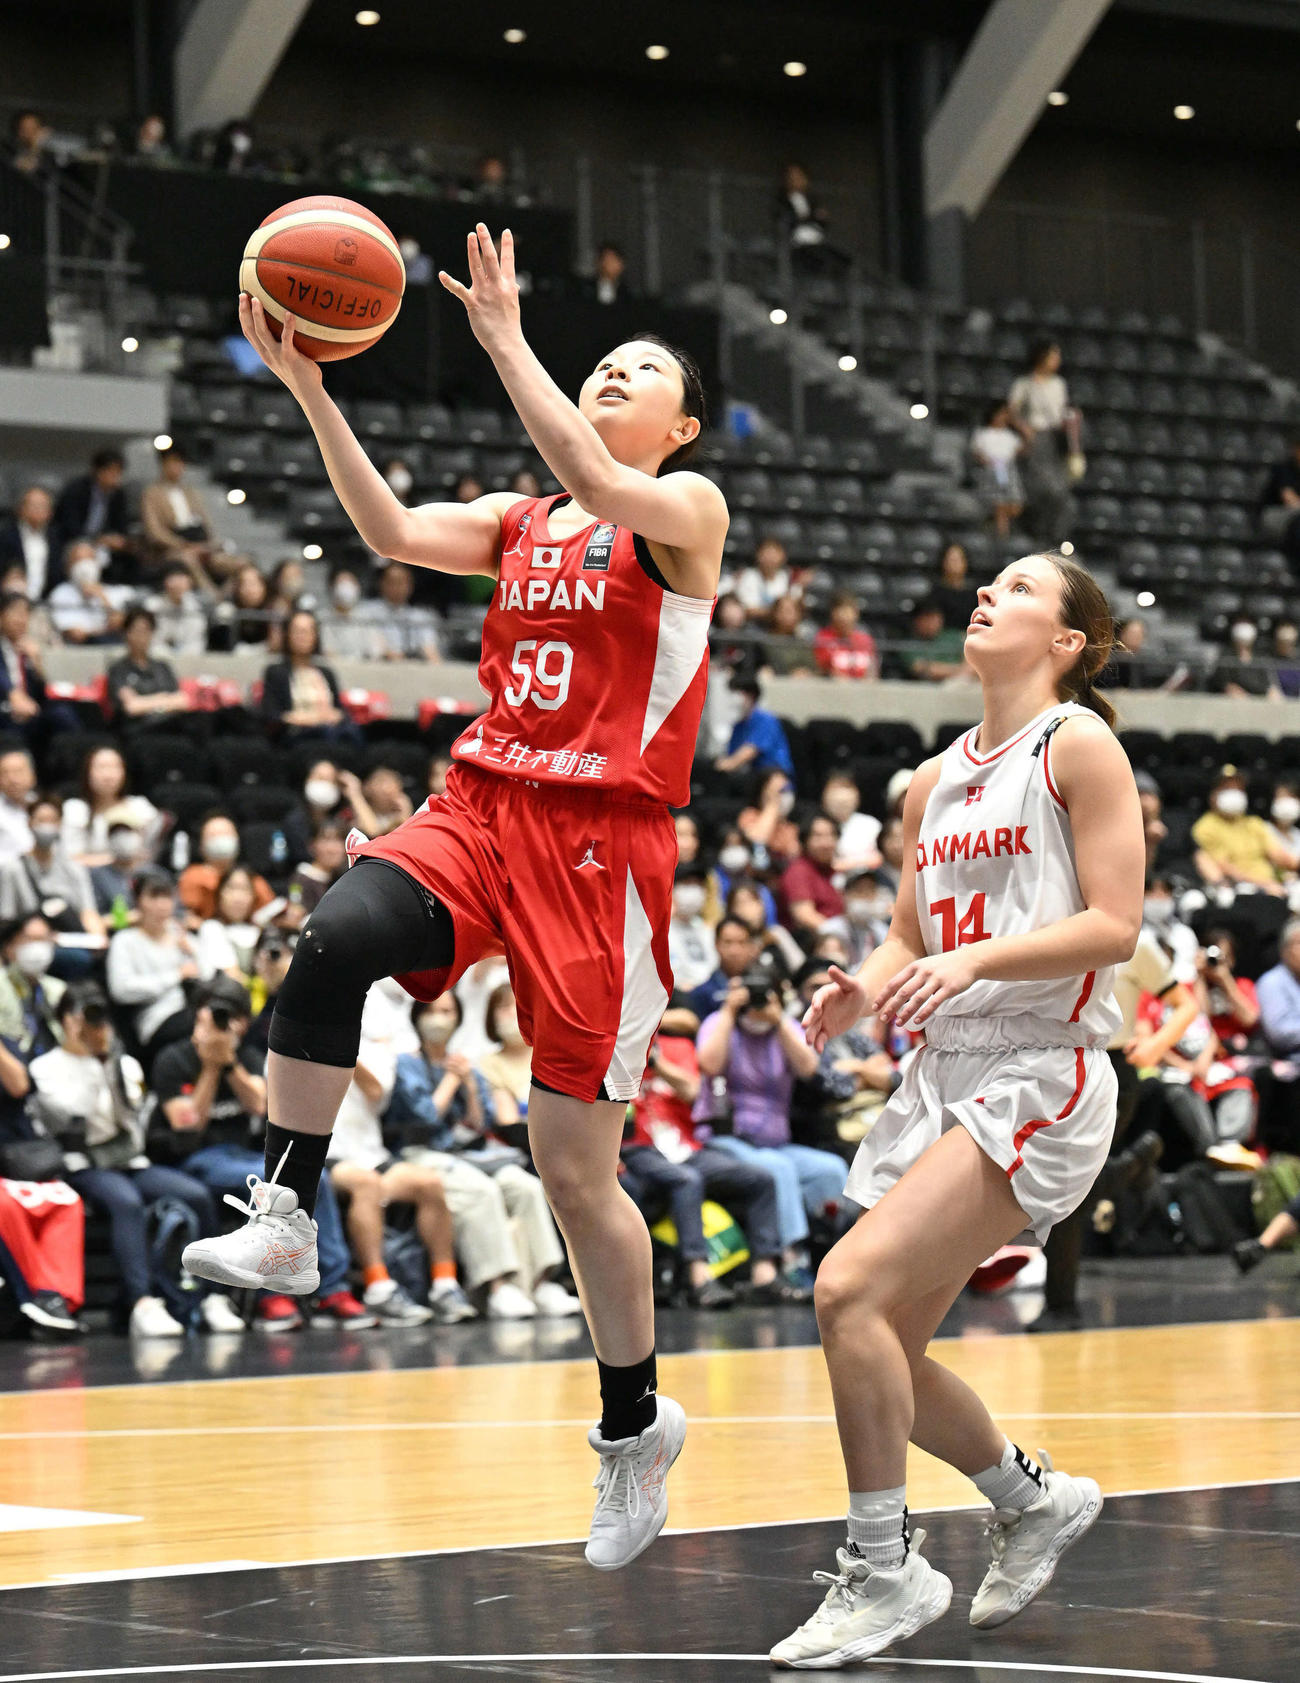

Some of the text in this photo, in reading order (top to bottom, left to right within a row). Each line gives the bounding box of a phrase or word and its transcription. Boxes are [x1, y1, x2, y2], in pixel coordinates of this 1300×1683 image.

[286, 275, 382, 319] OFFICIAL
[588, 547, 608, 557] FIBA
[499, 579, 606, 611] JAPAN
[504, 639, 574, 711] 59
[484, 737, 608, 779] 三井不動産
[929, 892, 992, 953] 14
